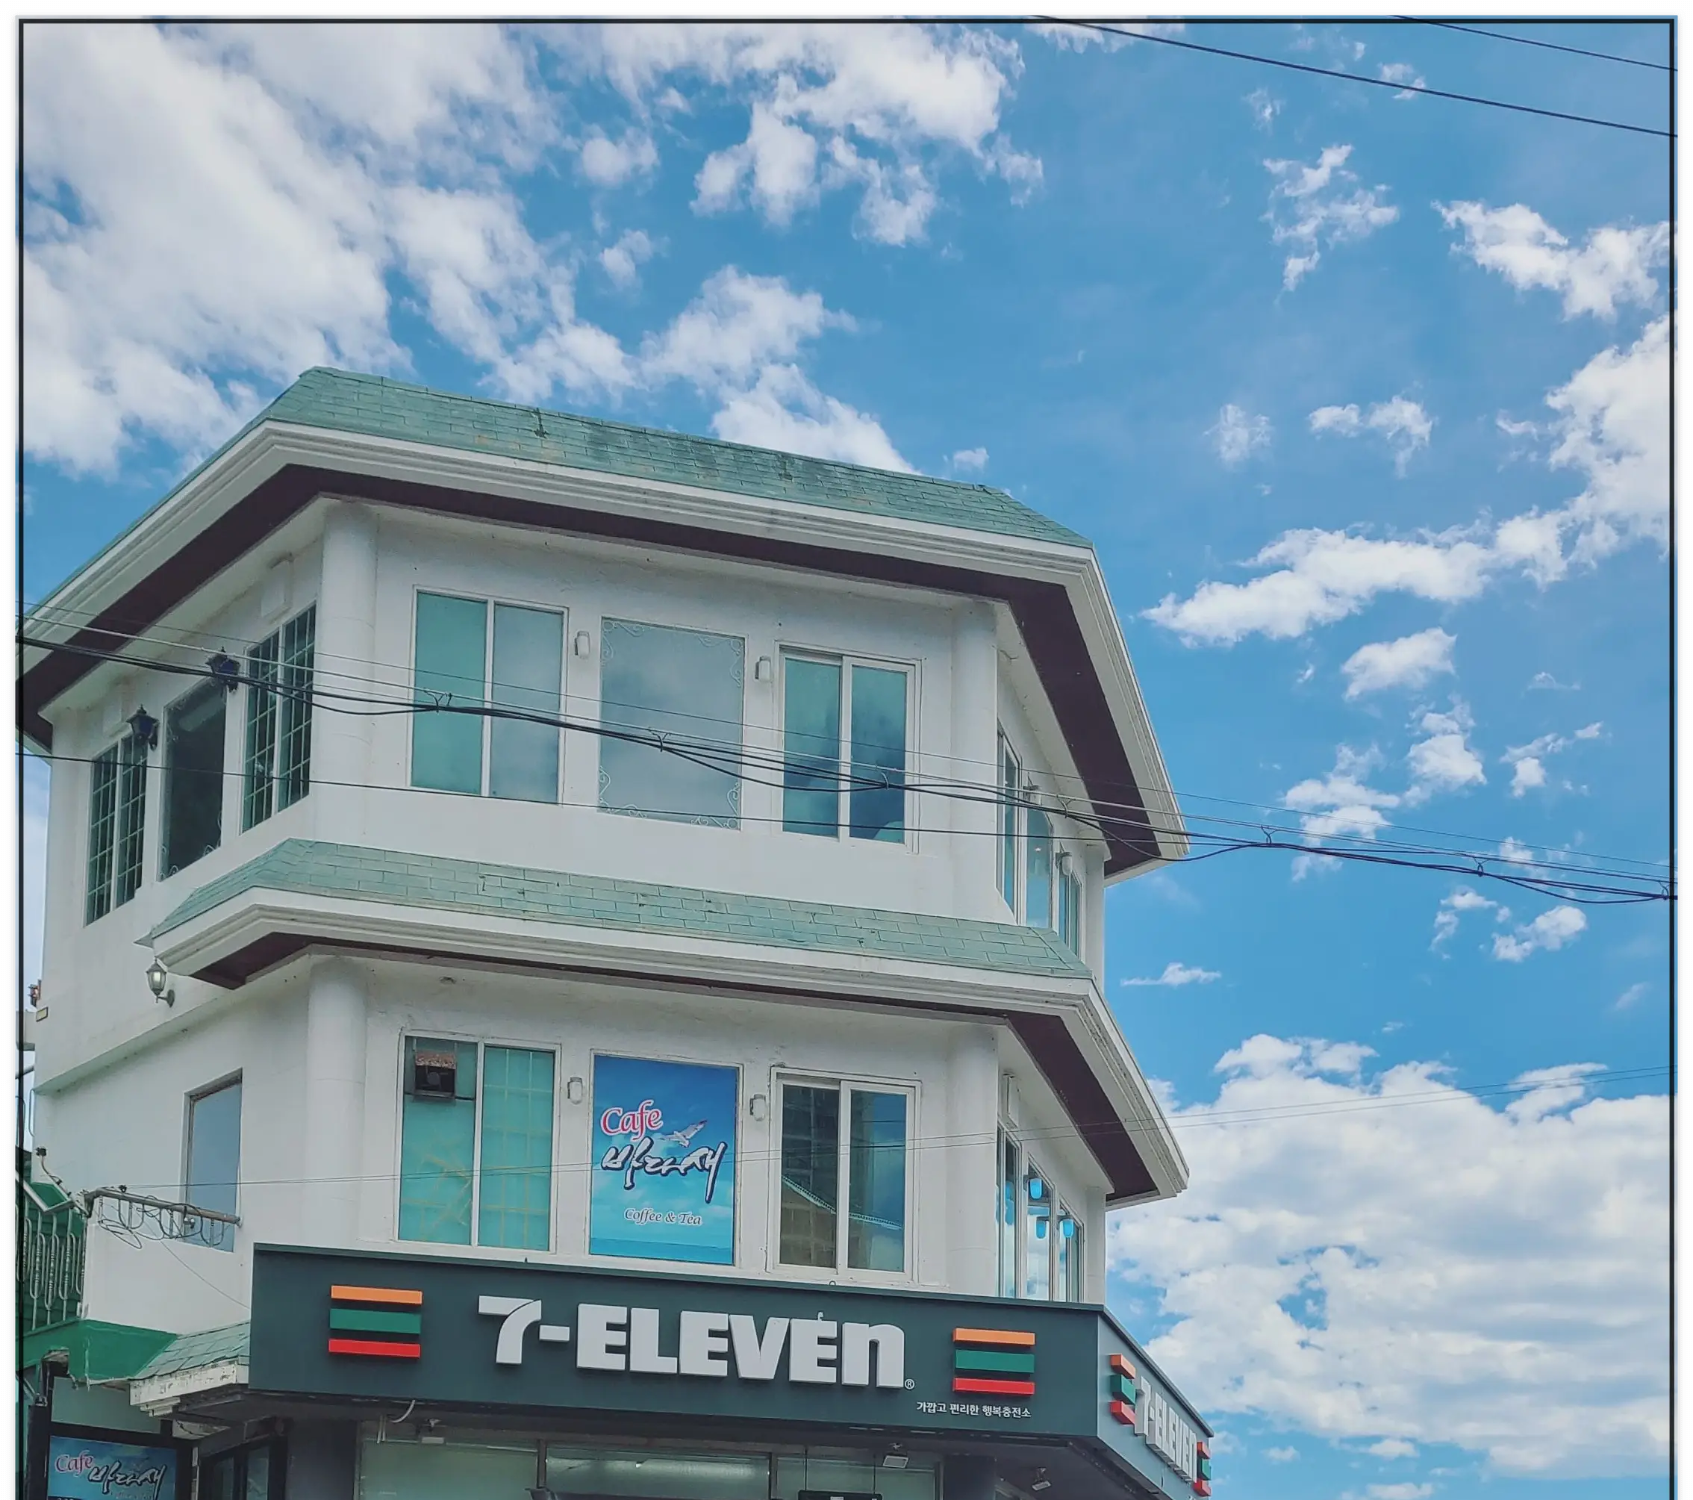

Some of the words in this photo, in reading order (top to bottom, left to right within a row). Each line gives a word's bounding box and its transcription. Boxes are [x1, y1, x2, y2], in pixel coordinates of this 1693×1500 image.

[600, 1099, 663, 1141] Cafe
[624, 1208, 662, 1225] Coffee
[665, 1211, 676, 1223] &
[678, 1212, 702, 1225] Tea
[916, 1401, 947, 1414] 가깝고
[950, 1403, 979, 1416] 편리한
[982, 1404, 1032, 1418] 행복충전소
[54, 1450, 94, 1477] Cafe
